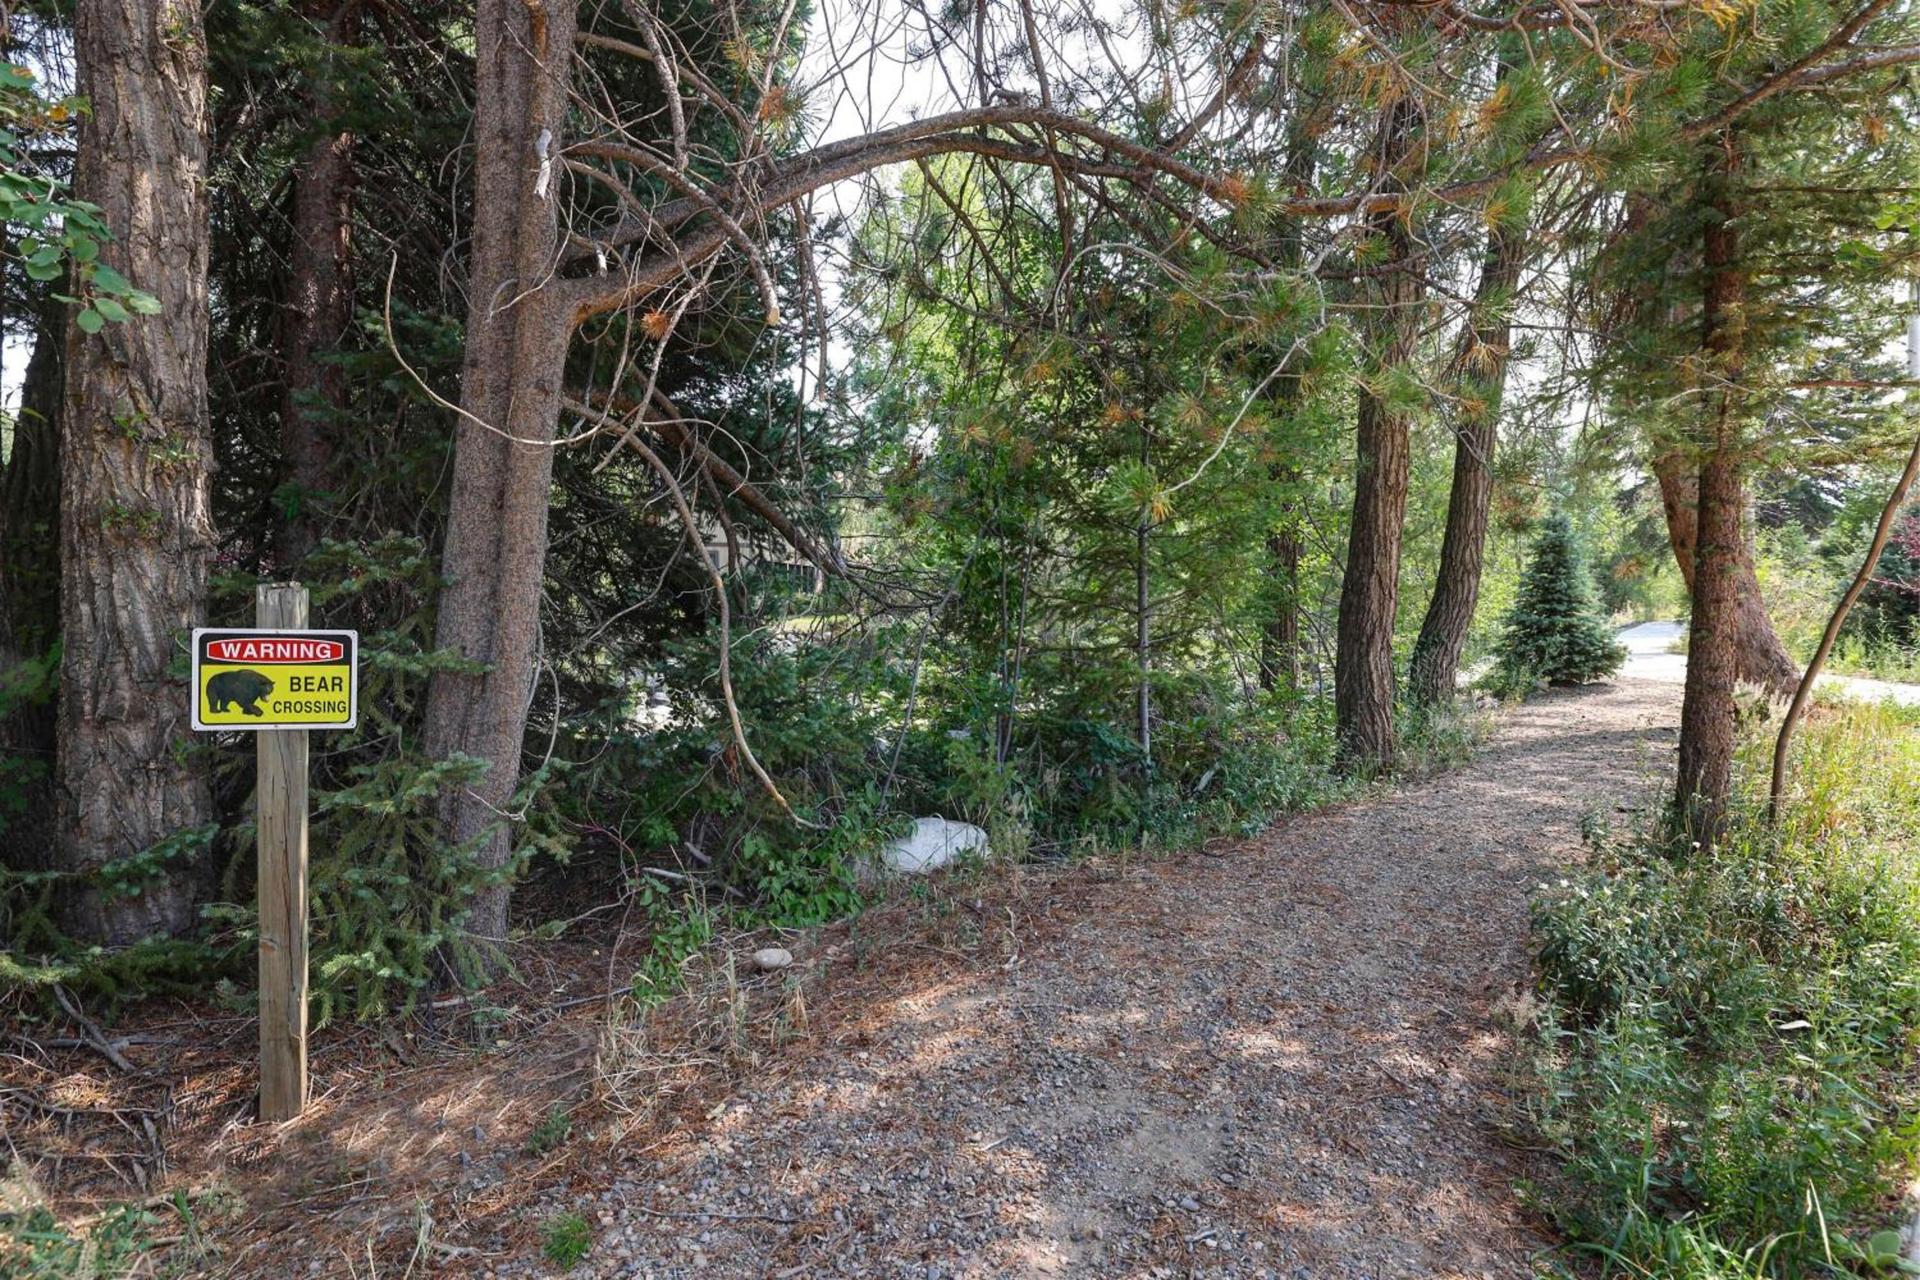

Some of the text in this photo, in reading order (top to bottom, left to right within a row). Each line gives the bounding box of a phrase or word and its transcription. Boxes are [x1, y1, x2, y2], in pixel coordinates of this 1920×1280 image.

[221, 643, 331, 659] WARNING
[290, 676, 343, 692] BEAR
[273, 701, 346, 714] CROSSING
